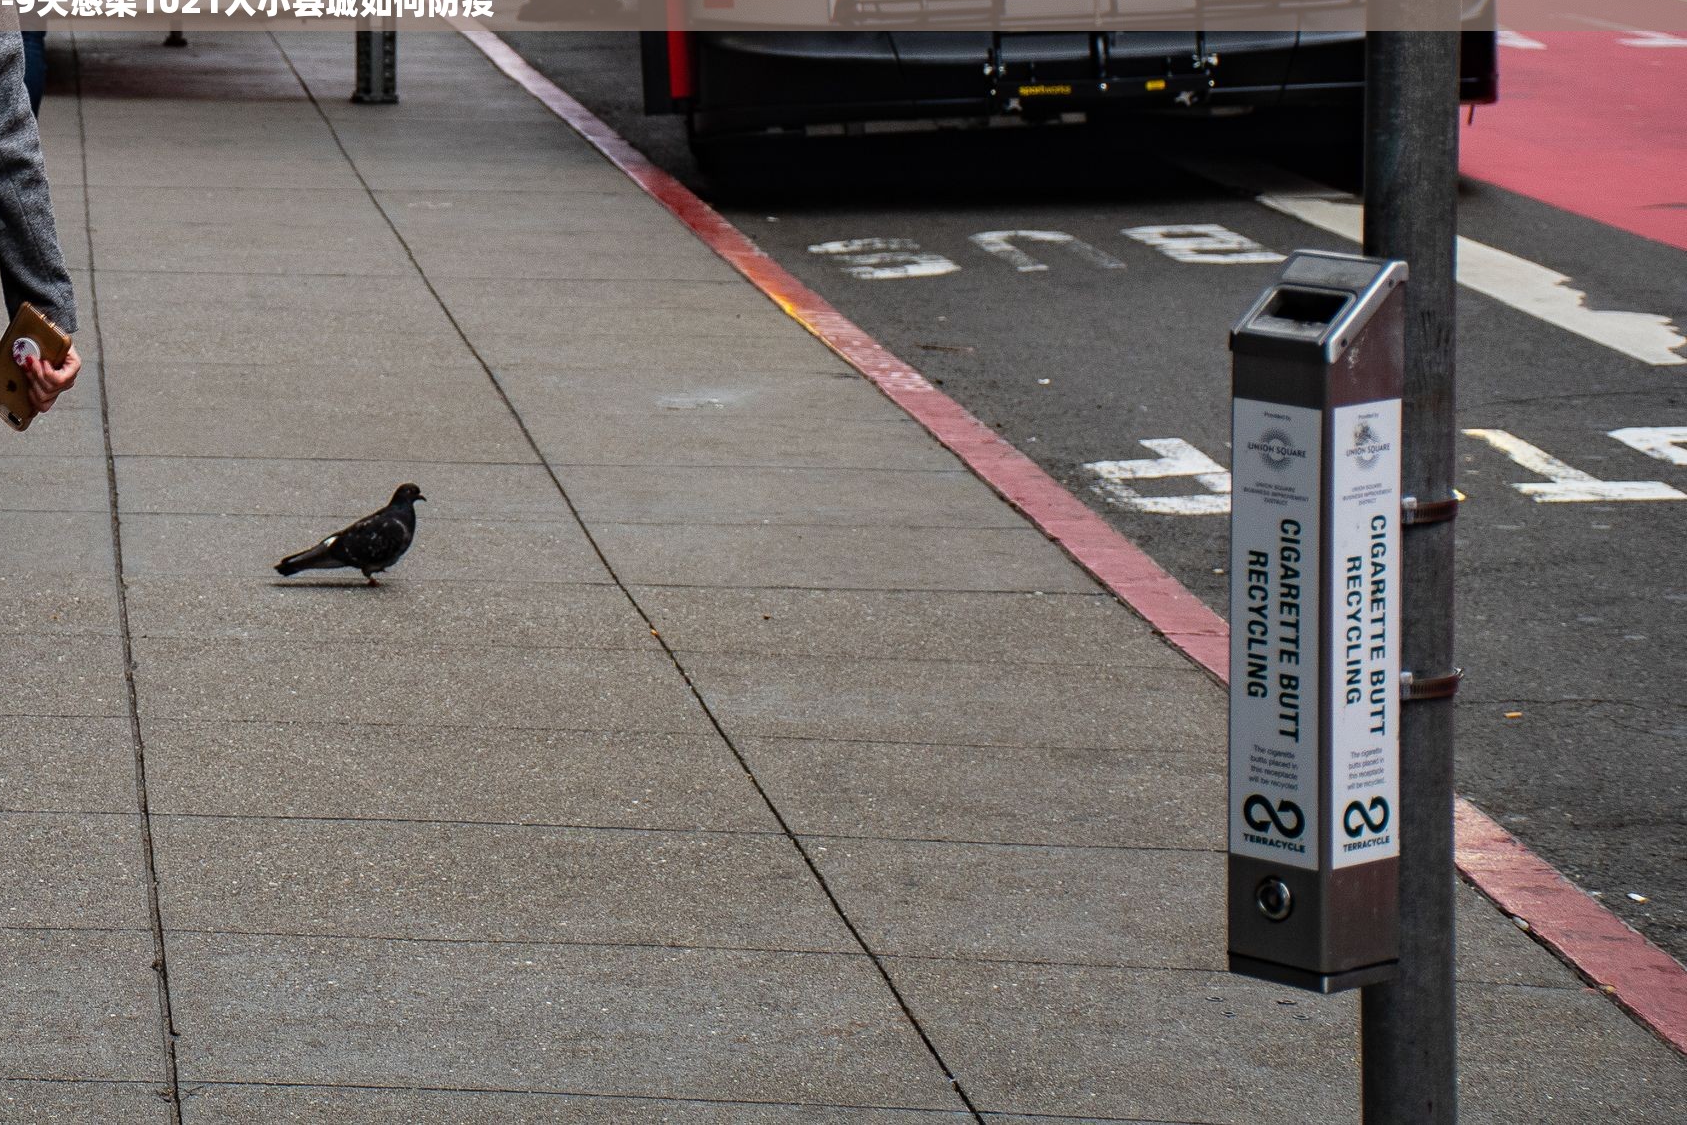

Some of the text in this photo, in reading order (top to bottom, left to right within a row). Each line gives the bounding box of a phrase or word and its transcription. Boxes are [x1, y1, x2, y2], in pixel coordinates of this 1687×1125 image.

[1247, 442, 1306, 458] UNION SQUARE
[1346, 443, 1390, 457] UNION SQUARE
[1247, 550, 1269, 699] RECYCLING
[1278, 519, 1301, 743] CIGARETTE BUTT
[1346, 556, 1362, 705] RECYCLING
[1370, 515, 1386, 736] CIGARETTE BUTT
[1254, 744, 1295, 759] The cigarette
[1250, 755, 1267, 765] butts
[1268, 758, 1291, 768] placed
[1243, 833, 1306, 853] TERRACYCLE
[1343, 835, 1390, 852] TERRACYCLE
